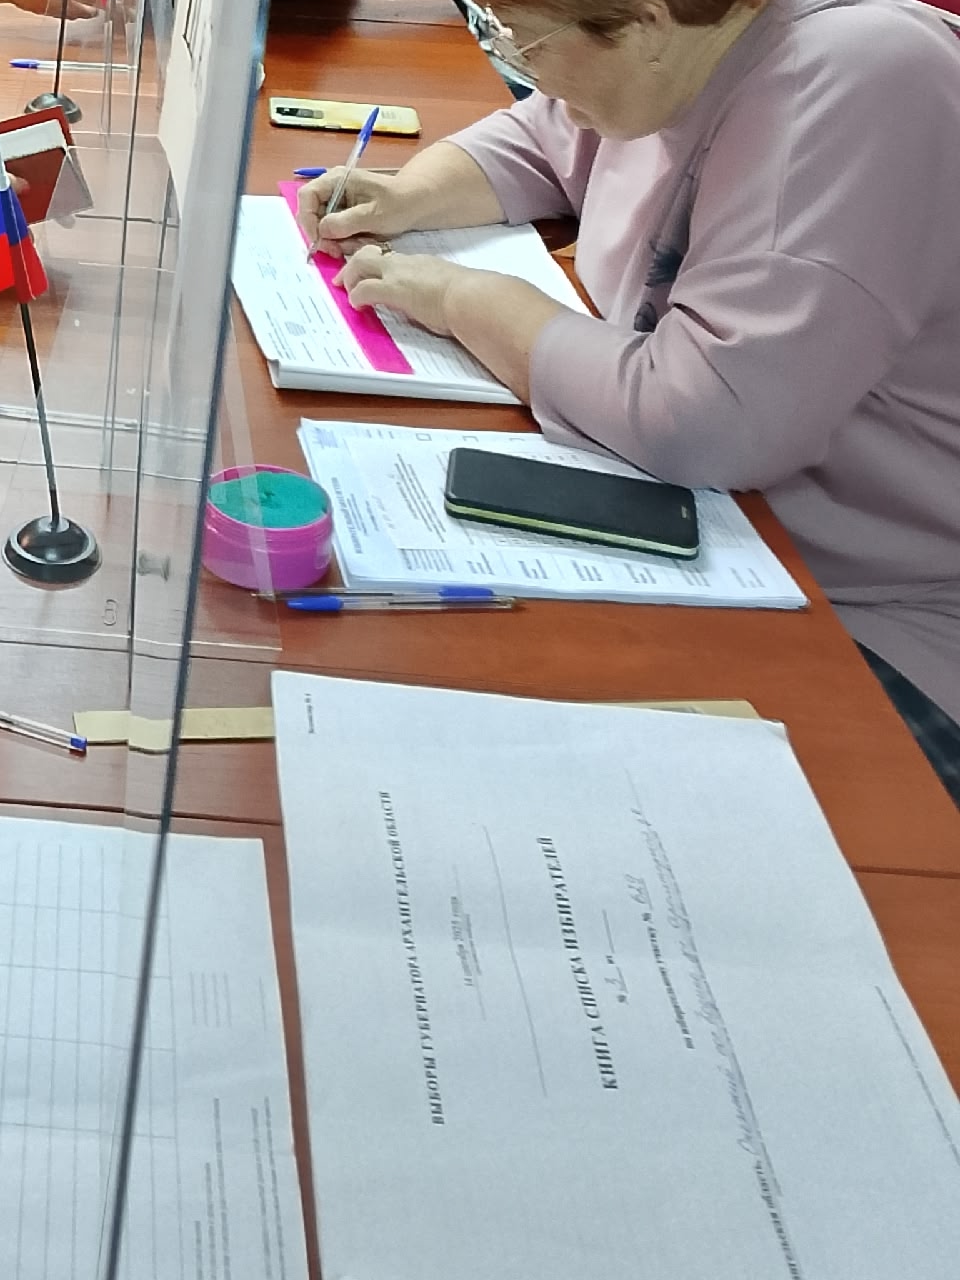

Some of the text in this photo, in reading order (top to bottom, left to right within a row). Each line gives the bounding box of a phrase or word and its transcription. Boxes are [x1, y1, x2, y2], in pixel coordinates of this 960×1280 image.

[379, 791, 445, 1125] ВЫБОРЫ ГУБЕРНАТОРА АРХАНГЕЛЬСКОЙ ОБЛАСТИ
[536, 836, 619, 1090] КНИГА СПИСКА ИЗБИРАТЕЛЕЙ
